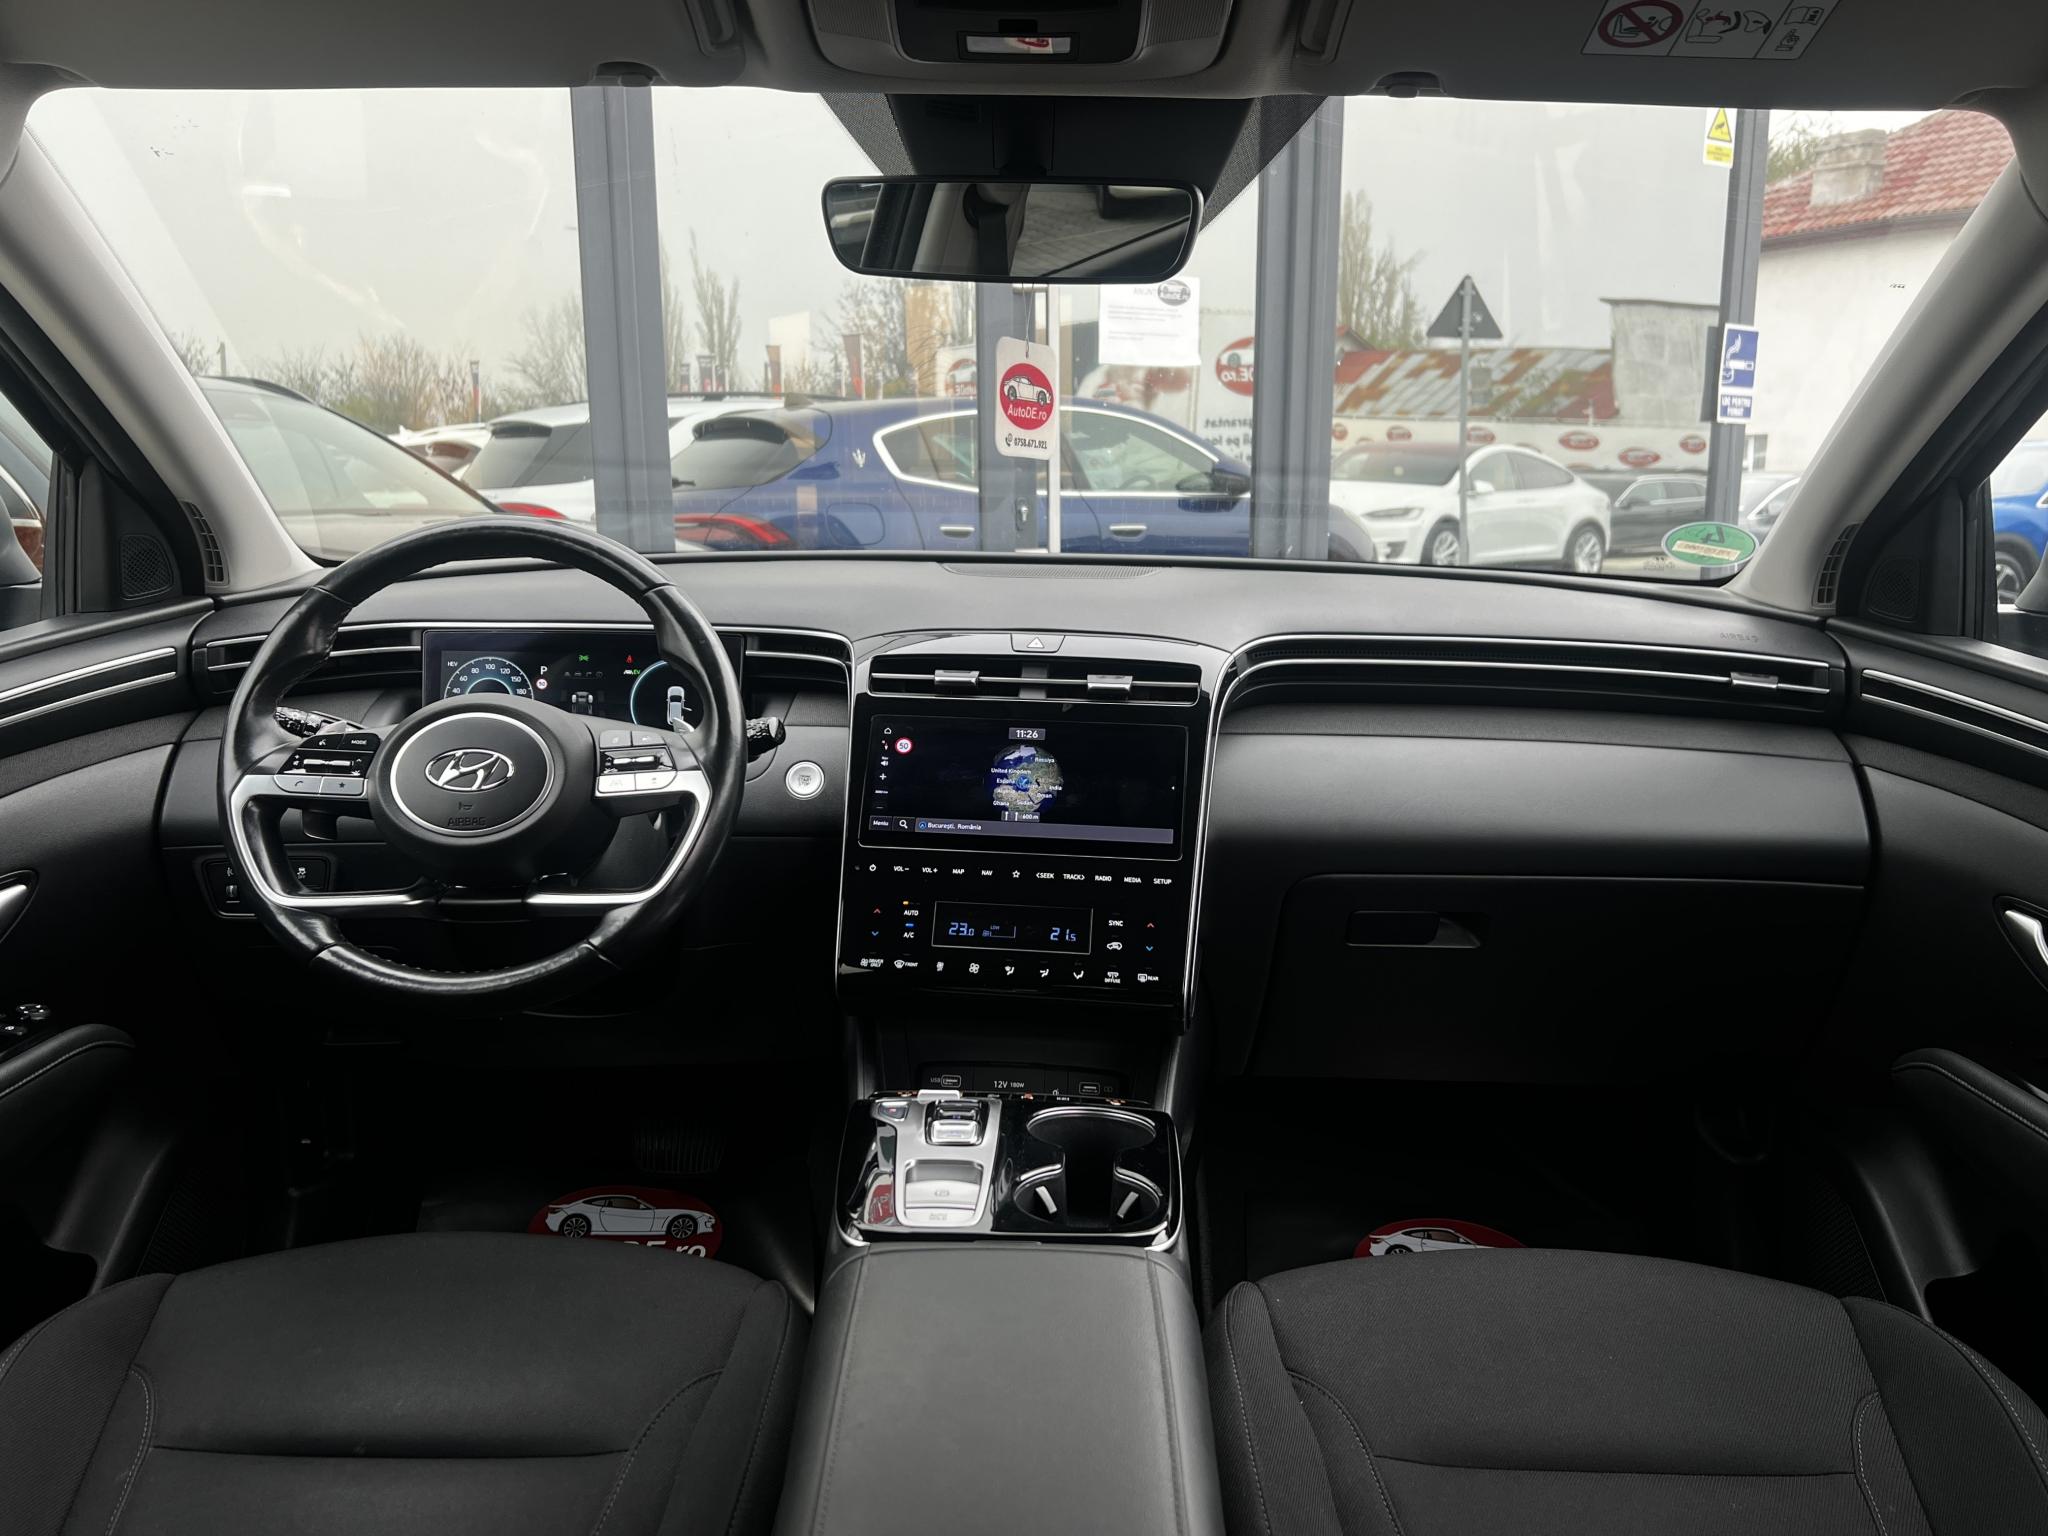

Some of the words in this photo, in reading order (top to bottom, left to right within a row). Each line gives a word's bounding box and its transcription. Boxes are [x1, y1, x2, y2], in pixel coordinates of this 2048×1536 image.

[1007, 404, 1048, 421] AutoDE.ro
[540, 666, 548, 675] P
[1015, 730, 1039, 739] 11:26
[899, 742, 909, 750] 50
[1123, 876, 1142, 884] MEDIA
[1108, 919, 1124, 927] SYNC
[903, 931, 915, 939] A/C
[993, 1080, 1008, 1089] 12V
